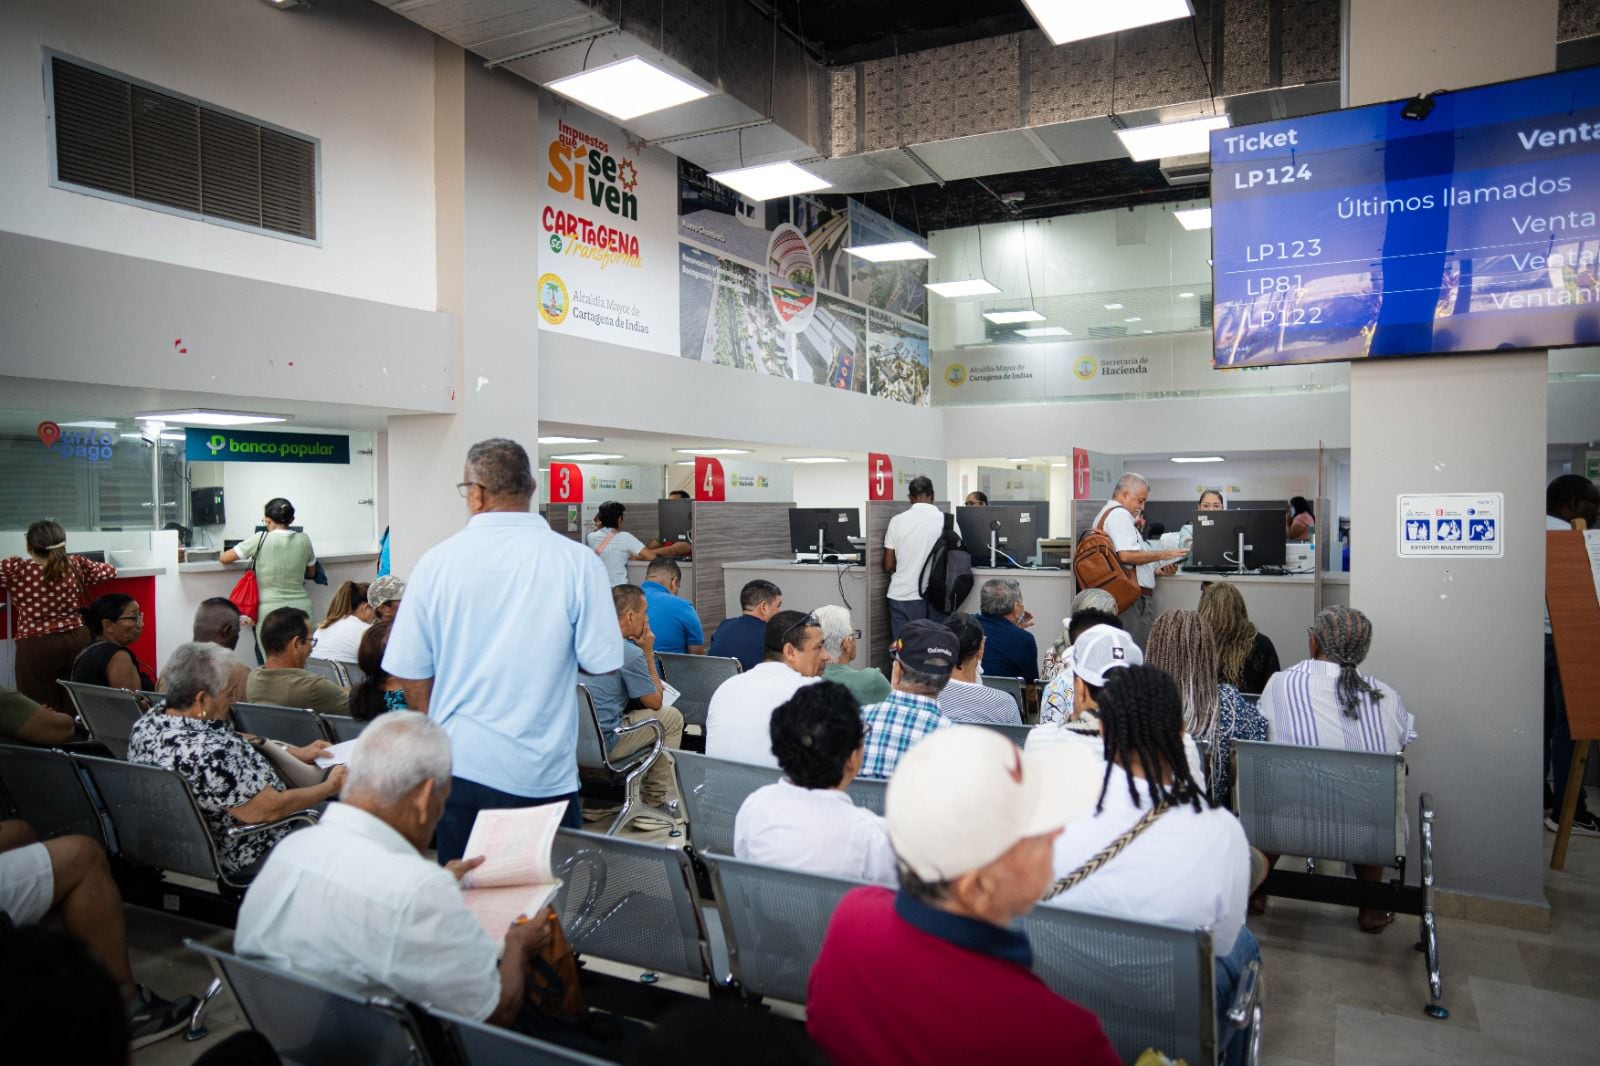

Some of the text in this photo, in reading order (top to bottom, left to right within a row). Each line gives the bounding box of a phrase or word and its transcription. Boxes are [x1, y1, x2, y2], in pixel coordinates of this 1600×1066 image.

[558, 119, 609, 153] Impuestos
[1224, 129, 1298, 154] Ticket
[547, 140, 617, 201] Sí se
[1235, 163, 1312, 190] LP124
[588, 176, 638, 221] ven
[1337, 176, 1572, 219] Últimos llamados
[542, 205, 640, 259] CARTAGENA
[1511, 211, 1596, 235] Venta
[1246, 239, 1322, 262] LP123
[1511, 248, 1600, 272] Venta
[1247, 274, 1304, 296] LP81
[572, 290, 641, 316] Alcaldía Mayor de
[572, 306, 650, 334] Cartagena de Indias
[1247, 307, 1323, 328] LP122
[1101, 365, 1148, 376] Hacienda
[62, 445, 113, 461] pago
[229, 438, 278, 454] banco
[280, 441, 335, 457] popular
[559, 466, 571, 499] 3
[703, 463, 714, 497] 4
[876, 459, 885, 497] 5
